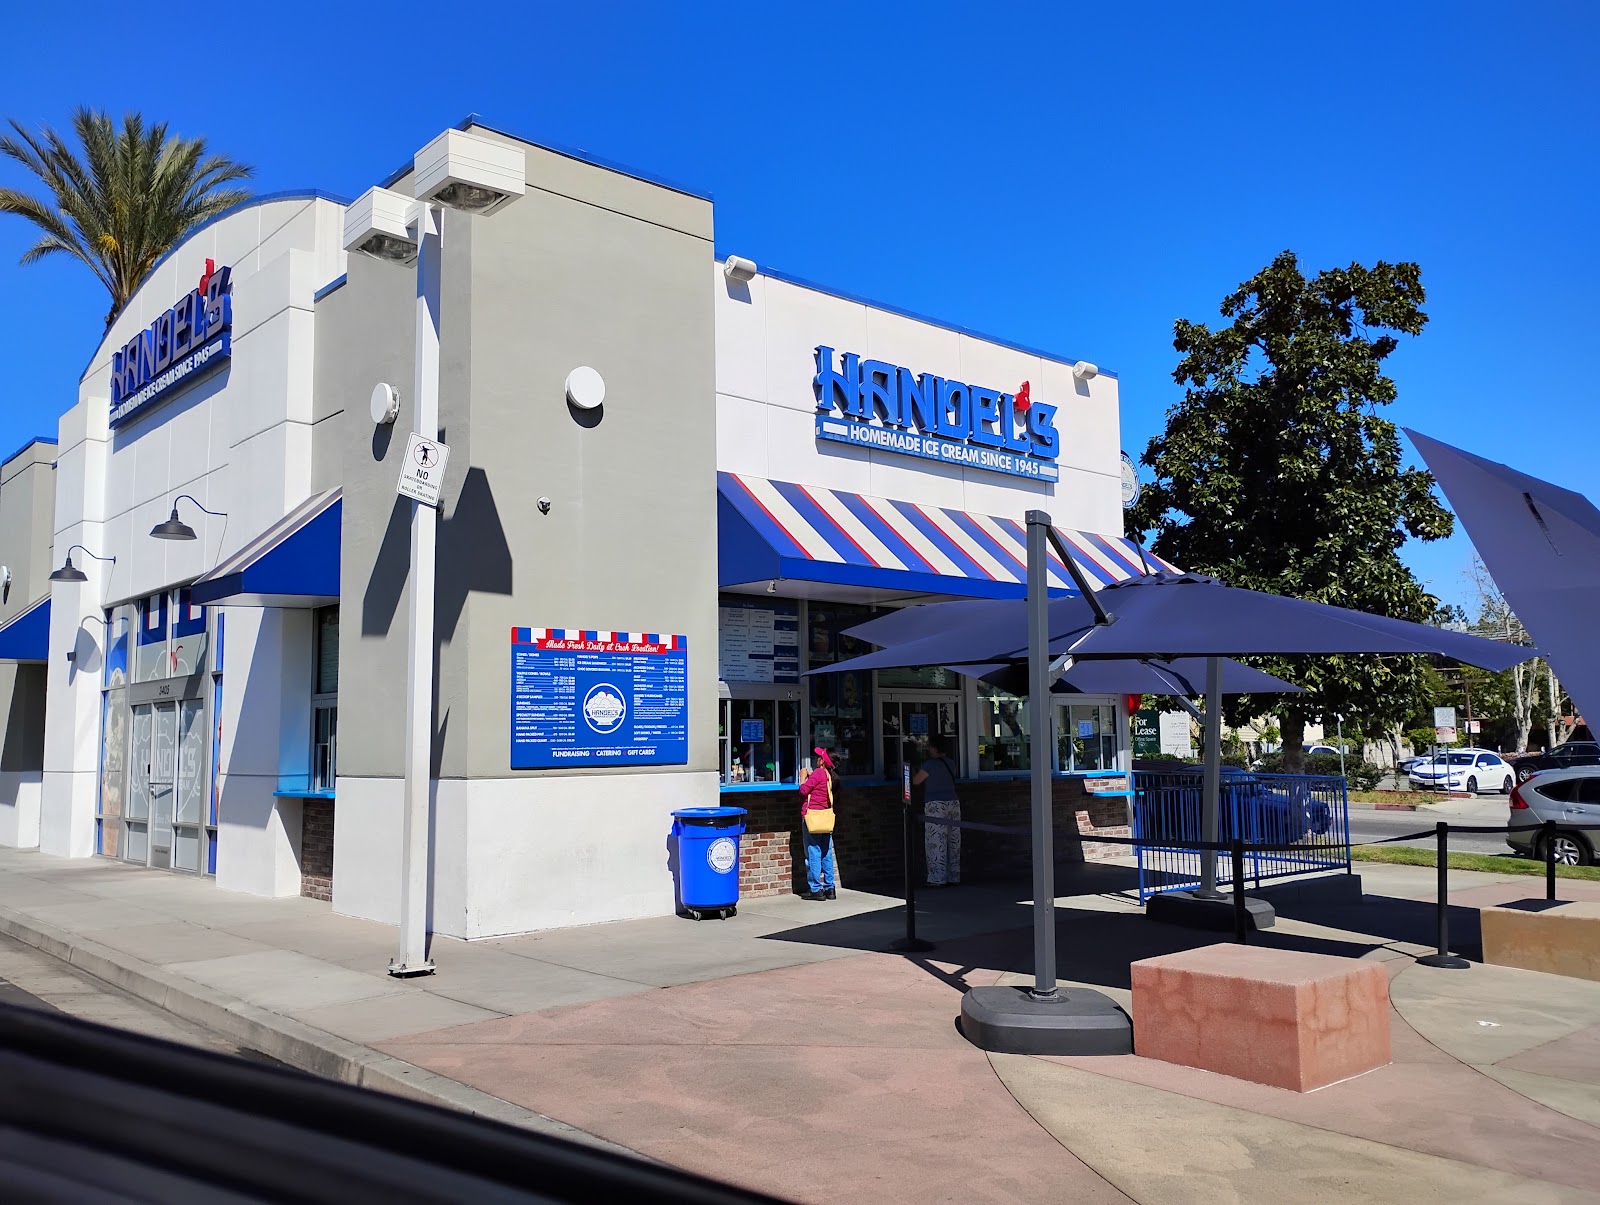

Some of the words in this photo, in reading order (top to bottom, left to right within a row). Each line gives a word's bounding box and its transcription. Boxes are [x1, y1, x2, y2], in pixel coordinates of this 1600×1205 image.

[110, 258, 234, 406] HANDEL'S
[156, 369, 175, 393] CREAM
[175, 357, 193, 379] SINCE
[193, 346, 210, 368] 1945
[813, 345, 1060, 458] HANDEL'S
[850, 424, 921, 453] HOMEMADE
[922, 438, 939, 456] ICE
[941, 442, 979, 466] CREAM
[980, 451, 1012, 471] SINCE
[1014, 458, 1039, 475] 1945
[416, 469, 428, 480] NO
[545, 639, 565, 649] Made
[567, 640, 585, 650] Fresh
[586, 641, 605, 653] Daily
[606, 642, 614, 651] at
[614, 643, 630, 652] Each
[631, 644, 660, 653] Location!
[1135, 716, 1147, 726] For
[1135, 727, 1157, 735] Lease
[552, 750, 590, 758] FUNDRAISING
[596, 749, 621, 757] CATERING
